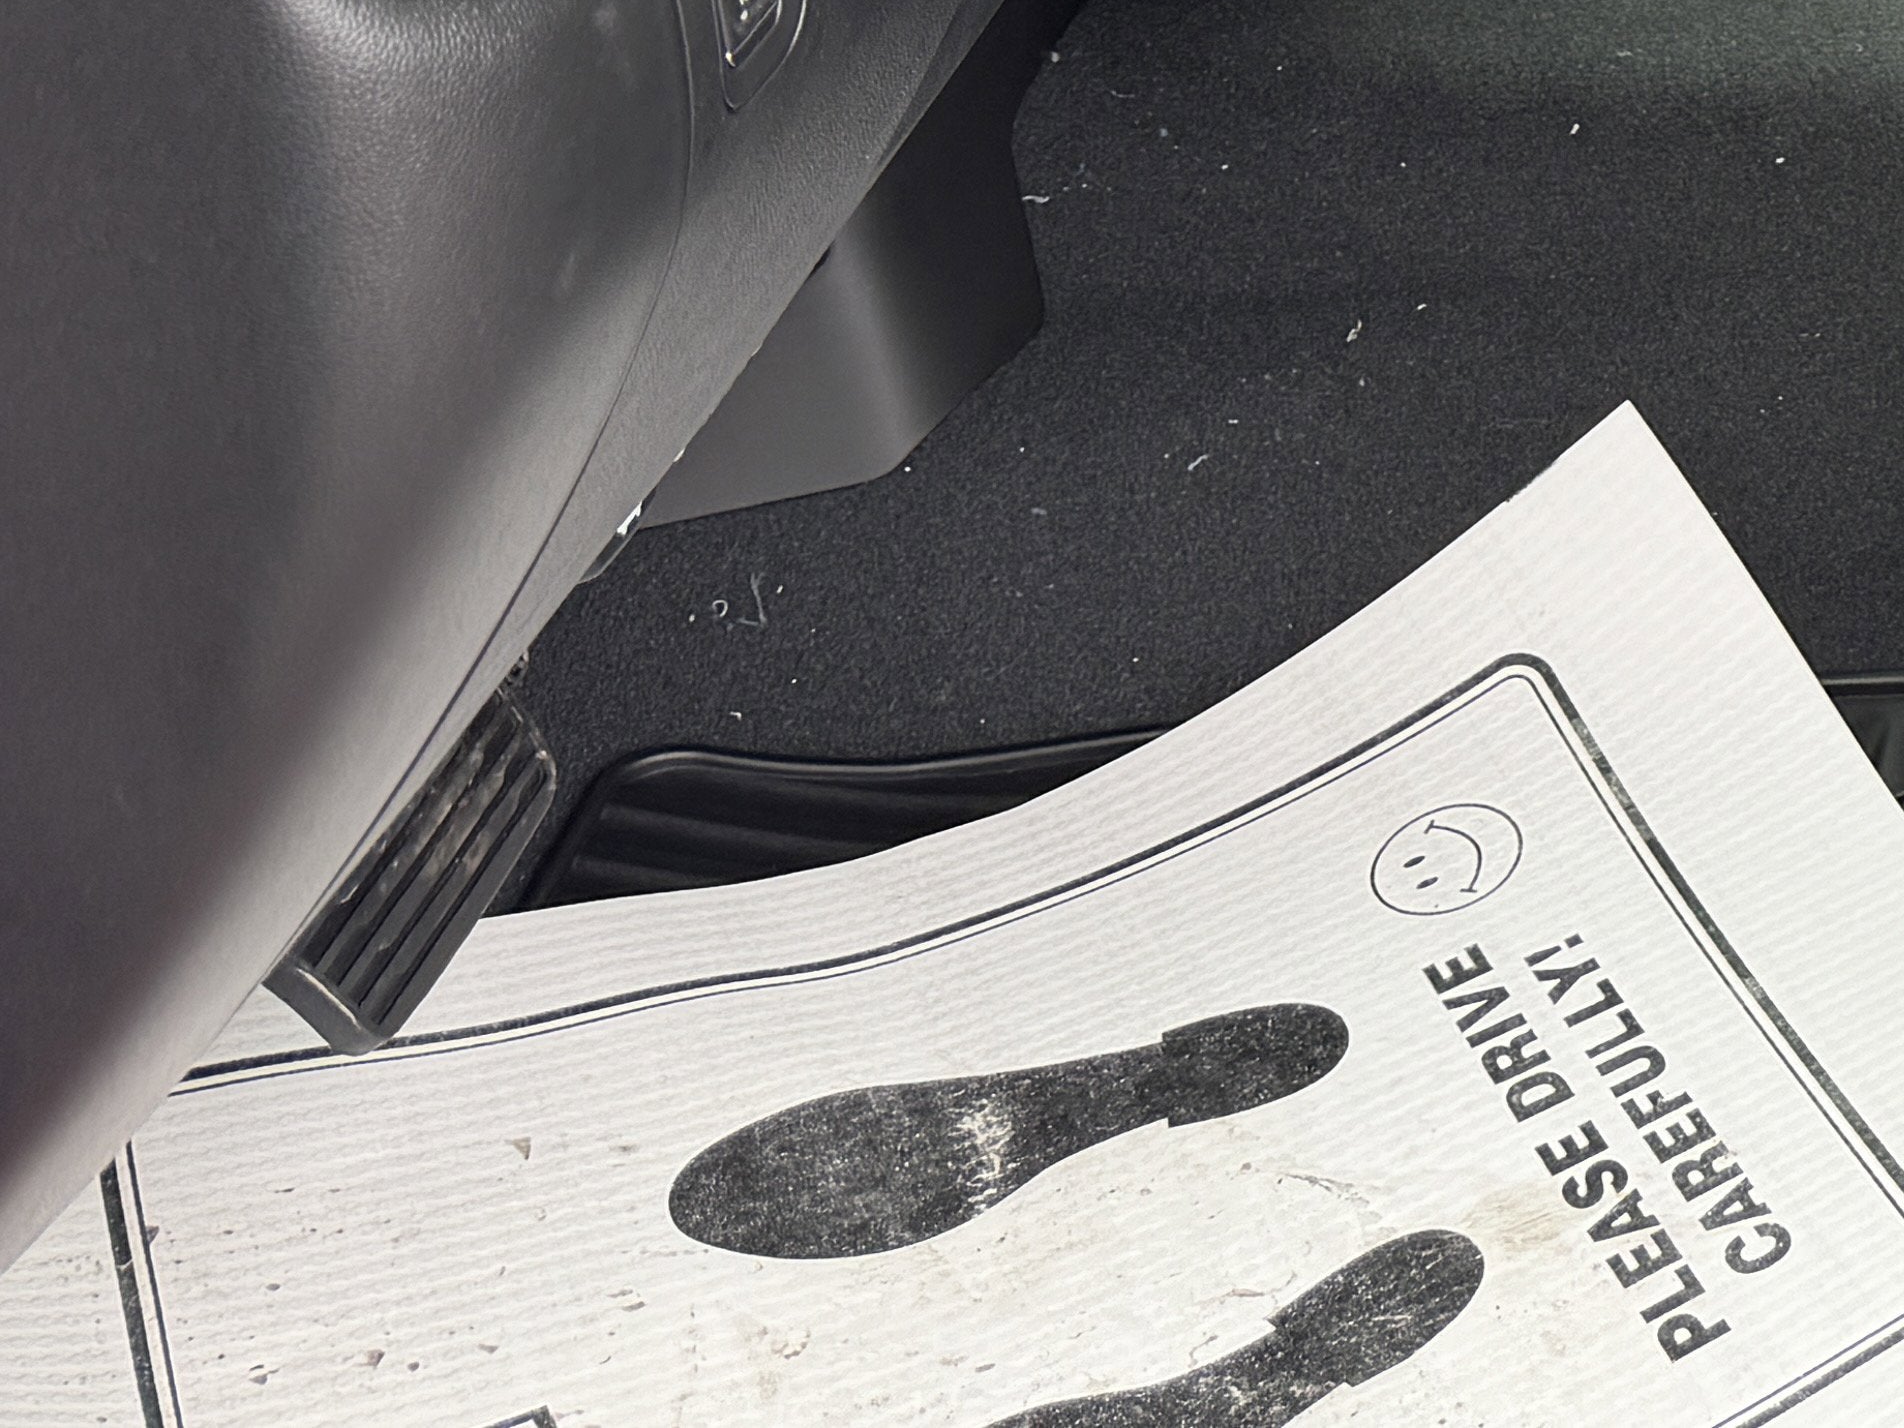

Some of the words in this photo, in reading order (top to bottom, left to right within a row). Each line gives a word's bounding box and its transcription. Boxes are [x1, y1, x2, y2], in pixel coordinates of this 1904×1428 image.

[1421, 943, 1575, 1123] DRIVE
[1524, 933, 1792, 1274] CAREFULLY!
[1534, 1120, 1732, 1363] PLEASE
